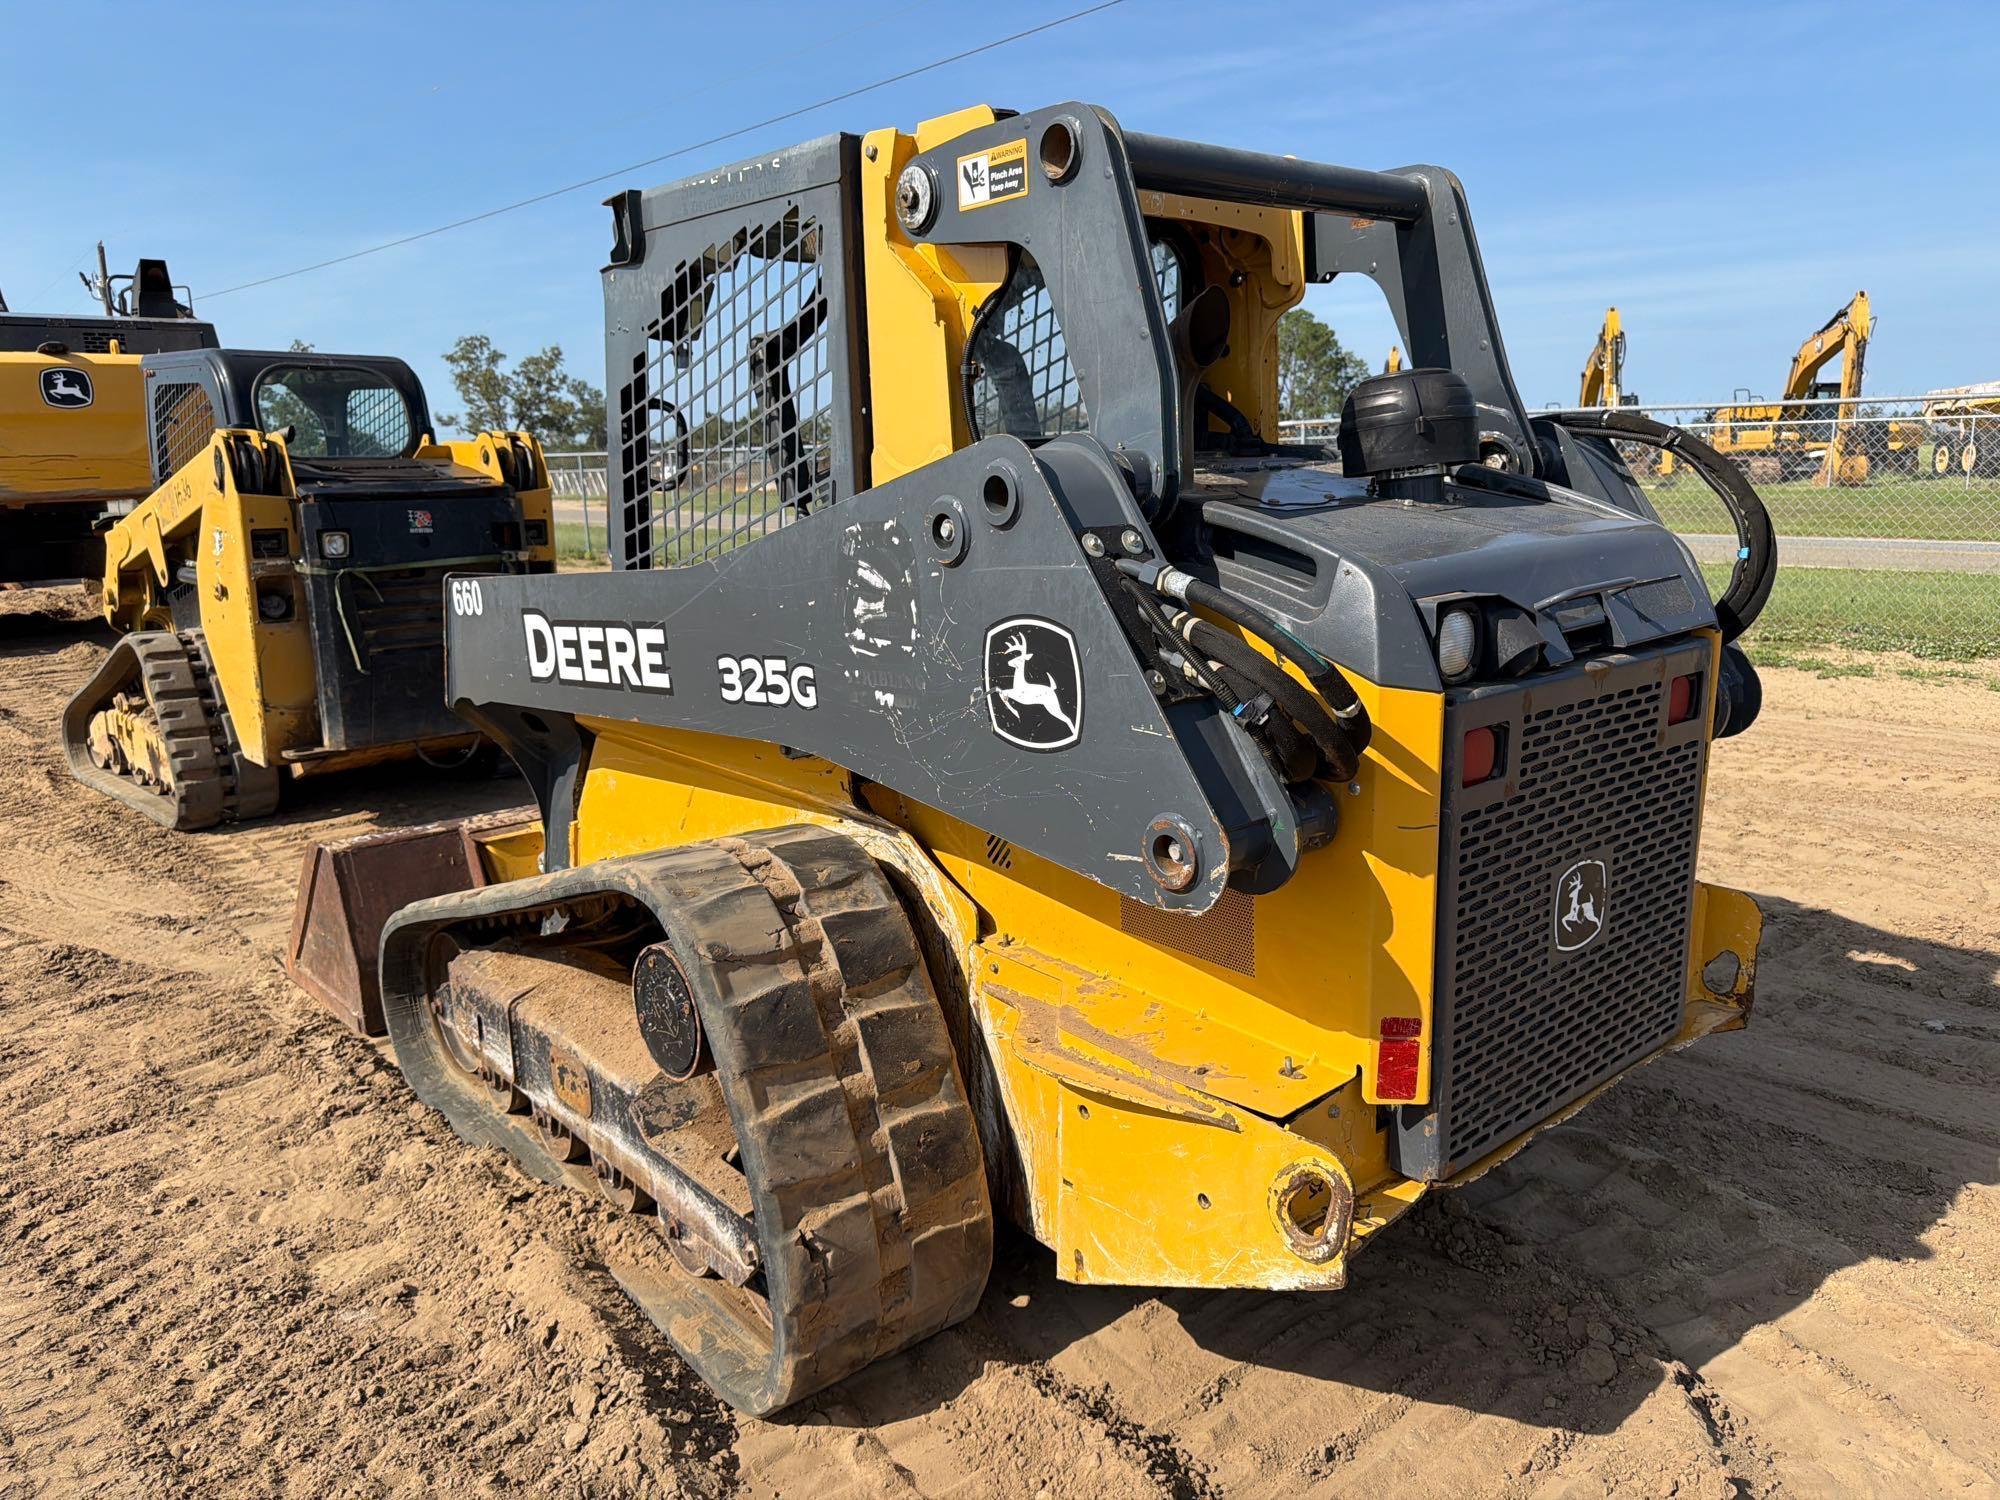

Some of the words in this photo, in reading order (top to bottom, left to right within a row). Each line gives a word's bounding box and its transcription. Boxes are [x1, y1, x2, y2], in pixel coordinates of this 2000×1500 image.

[996, 146, 1022, 157] WARNING
[991, 170, 1007, 181] Pinch
[1008, 167, 1022, 176] Area
[991, 183, 1004, 192] Keep
[1004, 179, 1018, 189] Away
[452, 580, 483, 616] 660
[523, 613, 671, 689] DEERE
[717, 655, 818, 709] 325G
